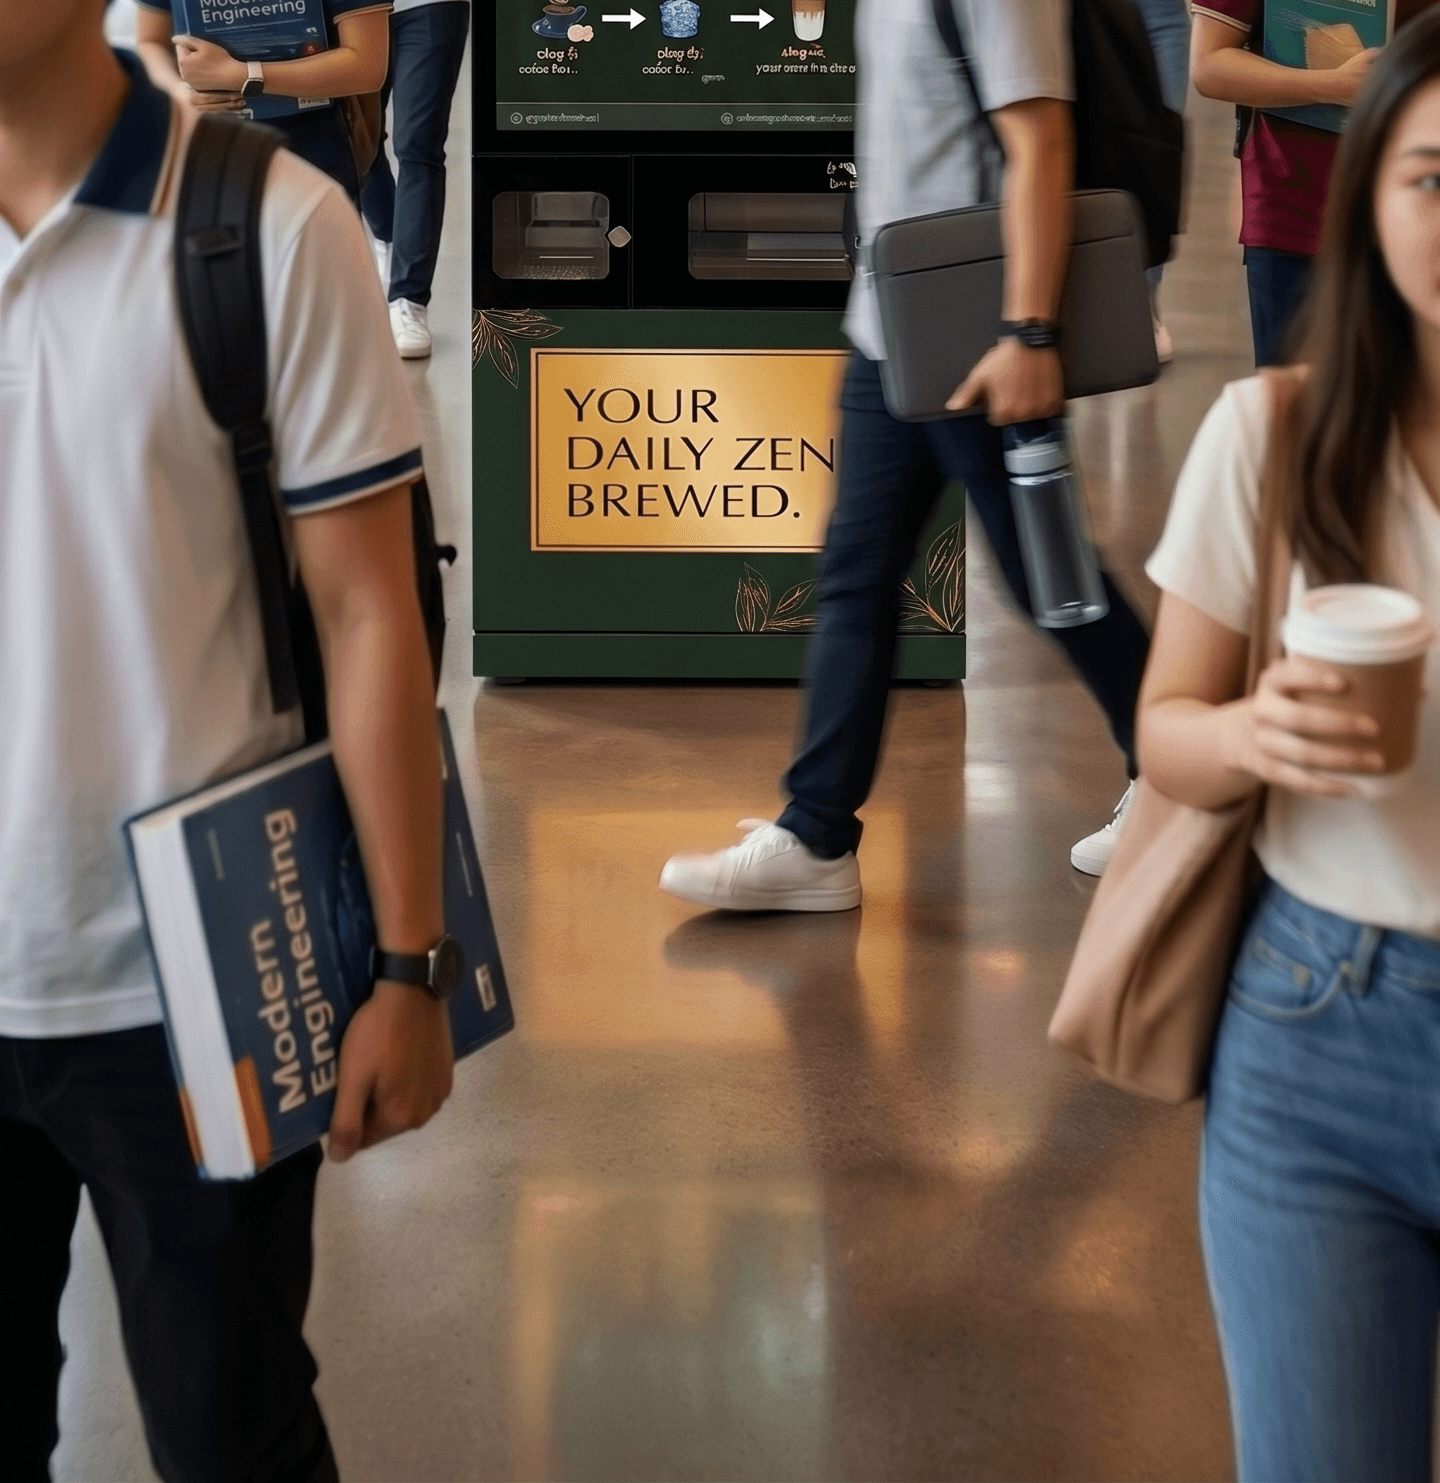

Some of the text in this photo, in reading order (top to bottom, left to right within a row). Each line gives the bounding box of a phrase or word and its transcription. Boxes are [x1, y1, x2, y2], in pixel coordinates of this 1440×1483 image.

[201, 0, 306, 24] Engineering
[563, 387, 719, 424] YOUR
[567, 436, 835, 473] DAILY ZEN
[568, 483, 800, 518] BREWED.
[265, 807, 337, 1098] Engineering
[250, 919, 307, 1114] Modern
